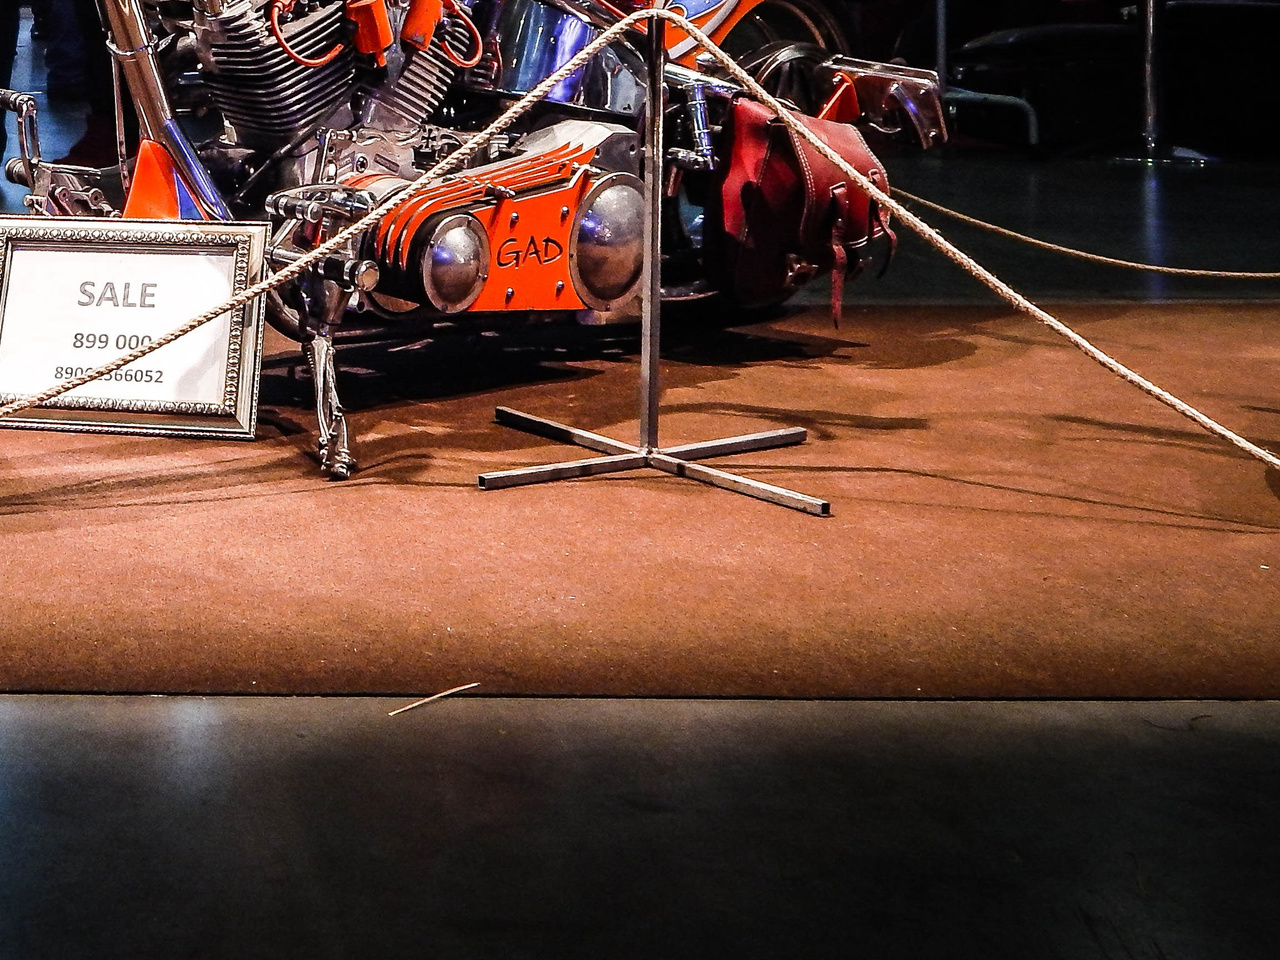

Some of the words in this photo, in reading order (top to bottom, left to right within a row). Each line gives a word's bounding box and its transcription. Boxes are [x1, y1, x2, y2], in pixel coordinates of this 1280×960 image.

[496, 235, 564, 269] GAD
[77, 281, 158, 308] SALE
[72, 332, 109, 349] 899
[115, 334, 153, 350] 000
[54, 366, 164, 383] 89066052
